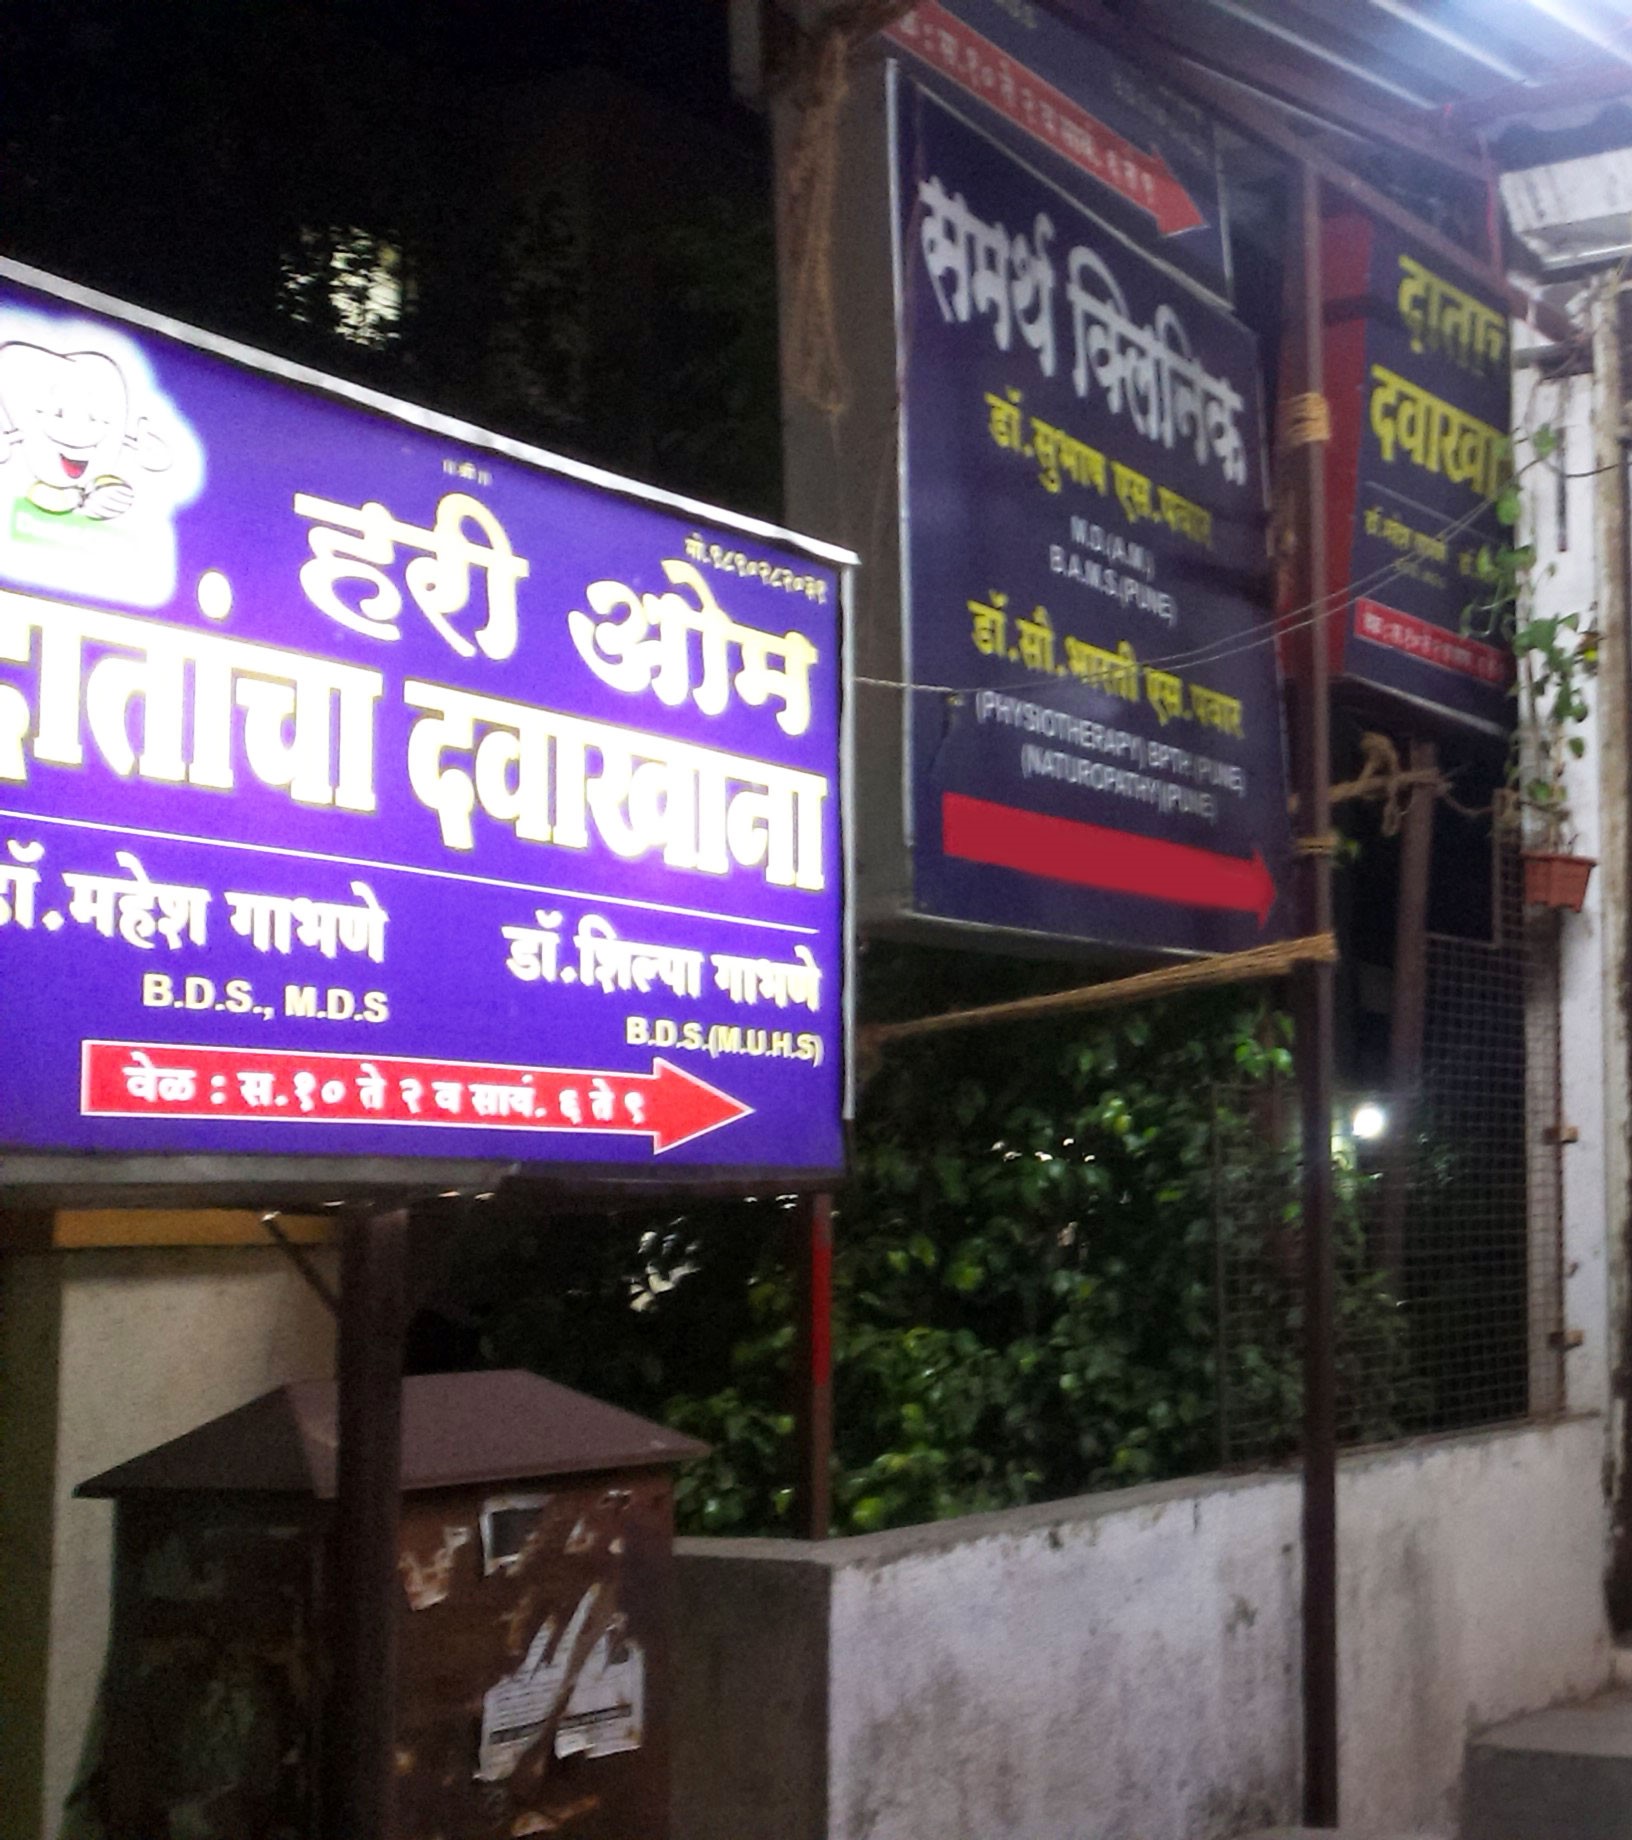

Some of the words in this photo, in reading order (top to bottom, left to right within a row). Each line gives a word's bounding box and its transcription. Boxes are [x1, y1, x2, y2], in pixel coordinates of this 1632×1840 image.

[918, 175, 1055, 378] समर्थ
[293, 492, 530, 662] हरी
[567, 559, 819, 735] ओम
[404, 680, 827, 893] दवाखाना
[122, 1050, 197, 1102] वेळ
[355, 1062, 387, 1110] ते
[399, 1076, 423, 1114] २
[431, 1080, 464, 1115] व
[559, 1088, 582, 1125] ६
[588, 1077, 616, 1122] ते
[284, 983, 390, 1024] M.D.S
